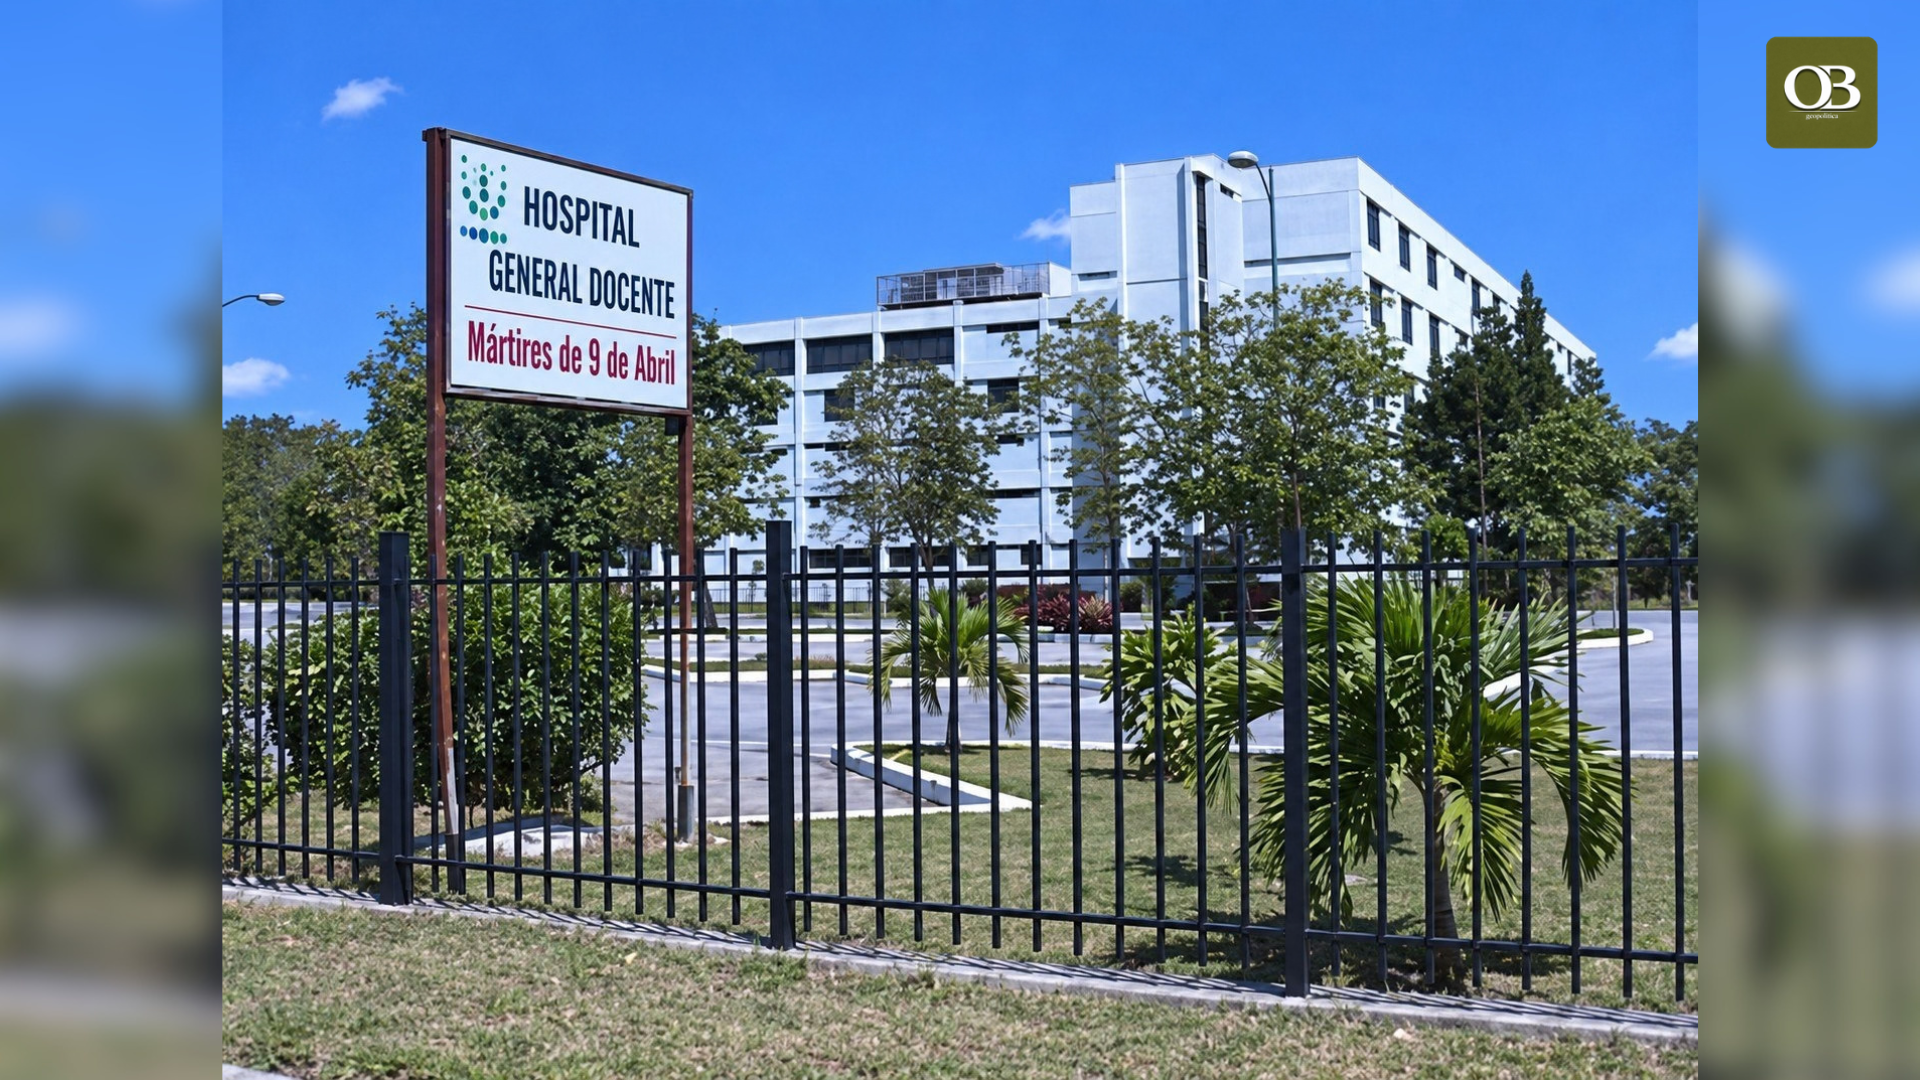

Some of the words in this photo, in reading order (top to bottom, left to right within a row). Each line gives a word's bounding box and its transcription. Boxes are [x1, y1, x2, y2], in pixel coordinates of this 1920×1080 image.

[524, 186, 640, 248] HOSPITAL
[489, 249, 583, 304] GENERAL
[589, 267, 675, 319] DOCENTE
[467, 320, 552, 371] Mártires
[559, 335, 582, 374] de
[589, 338, 601, 376] 9
[607, 341, 628, 379] de
[634, 345, 675, 385] Abril
